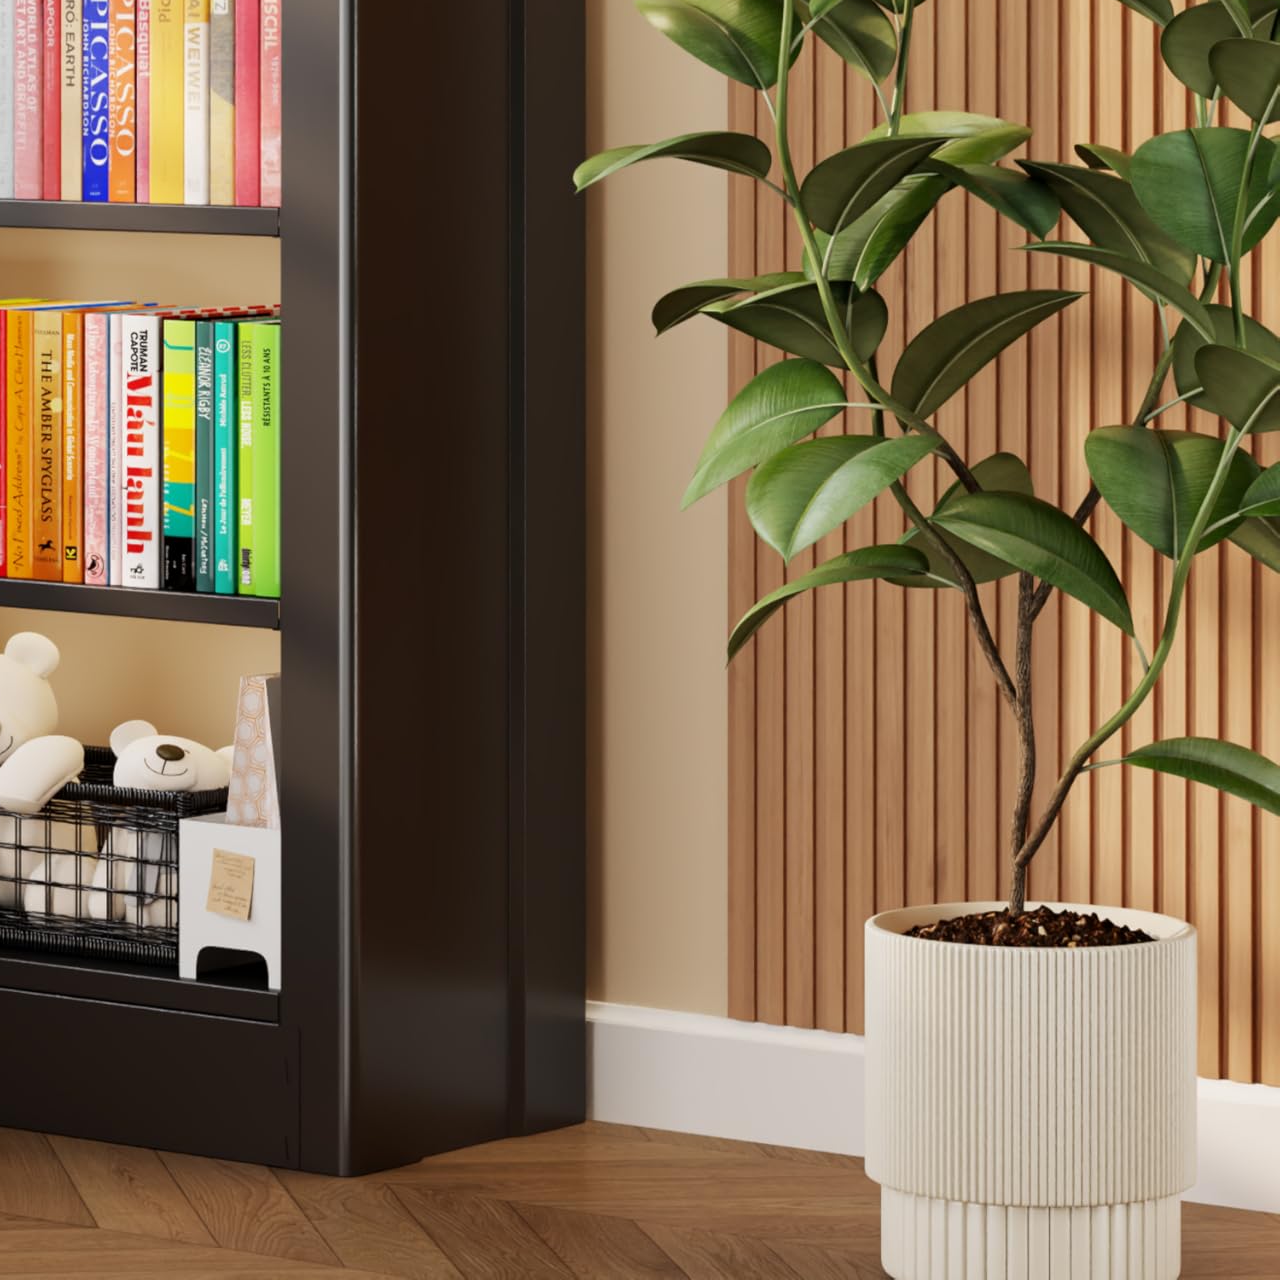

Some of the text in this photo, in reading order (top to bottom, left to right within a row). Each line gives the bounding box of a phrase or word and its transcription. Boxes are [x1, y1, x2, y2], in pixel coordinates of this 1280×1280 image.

[16, 18, 26, 46] ART
[16, 50, 26, 79] AND
[27, 47, 36, 92] ATLAS
[65, 32, 75, 87] EARTH
[188, 27, 201, 111] WEIWEI
[27, 96, 36, 113] OF
[130, 331, 138, 372] CAPOTE
[140, 329, 148, 372] TRUMAN
[241, 340, 252, 359] LESS
[262, 348, 271, 364] ANS
[198, 346, 212, 420] ELEANOR RIGBY
[40, 349, 53, 523] THE AMBER SPYGLASS
[126, 375, 155, 457] Máu
